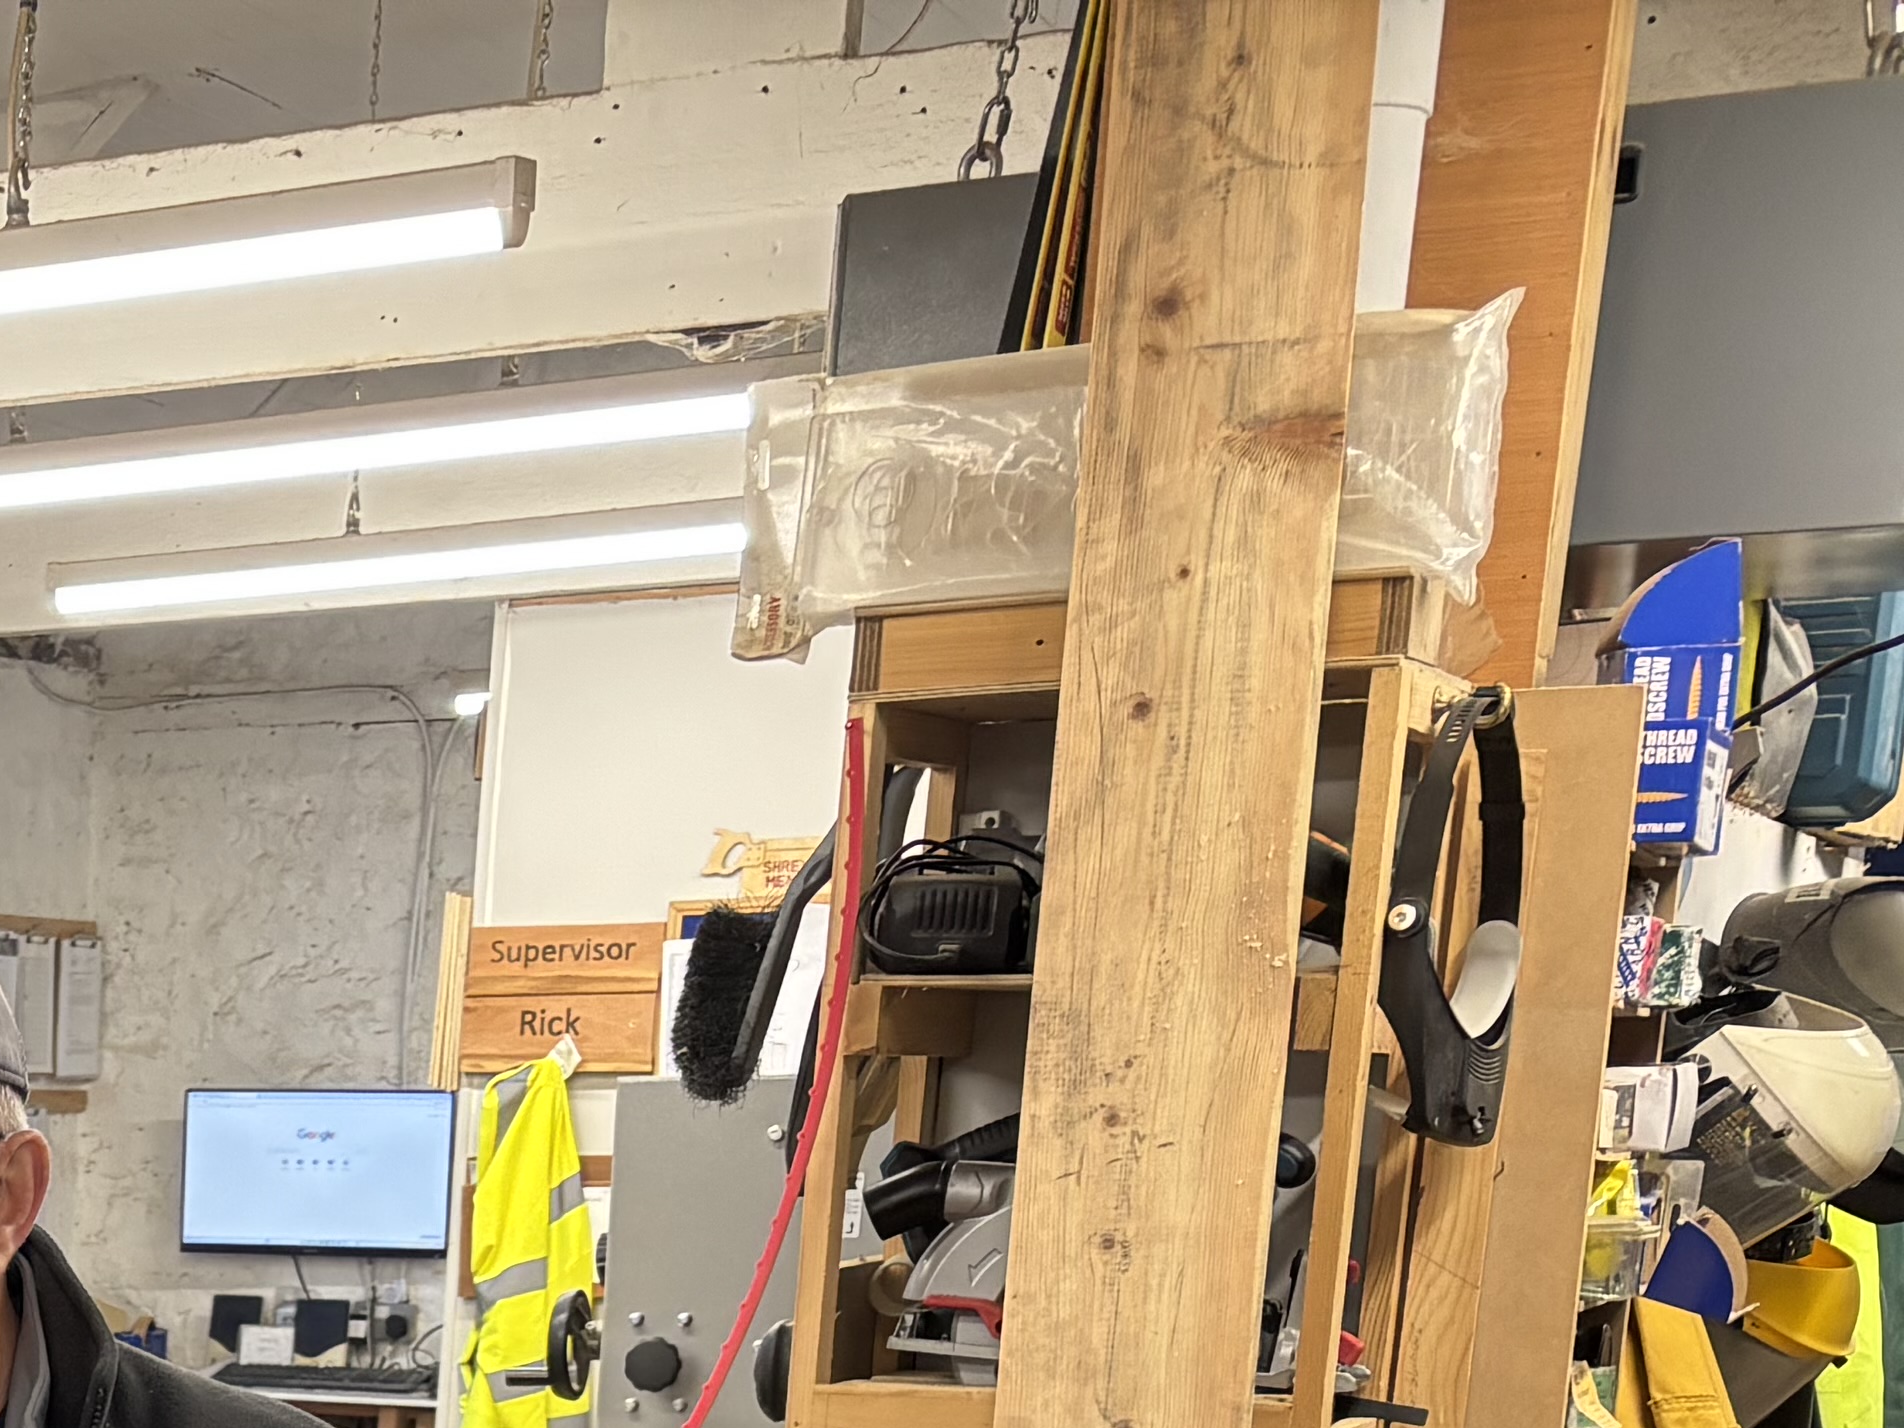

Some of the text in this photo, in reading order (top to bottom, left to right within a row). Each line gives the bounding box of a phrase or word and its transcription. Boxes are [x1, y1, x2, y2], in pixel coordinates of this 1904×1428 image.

[1633, 656, 1652, 684] EAD
[1647, 657, 1672, 721] DSCREW
[1639, 746, 1696, 765] CREW
[763, 859, 804, 874] SHRE
[490, 938, 637, 968] Supervisor
[519, 1007, 581, 1037] Rick
